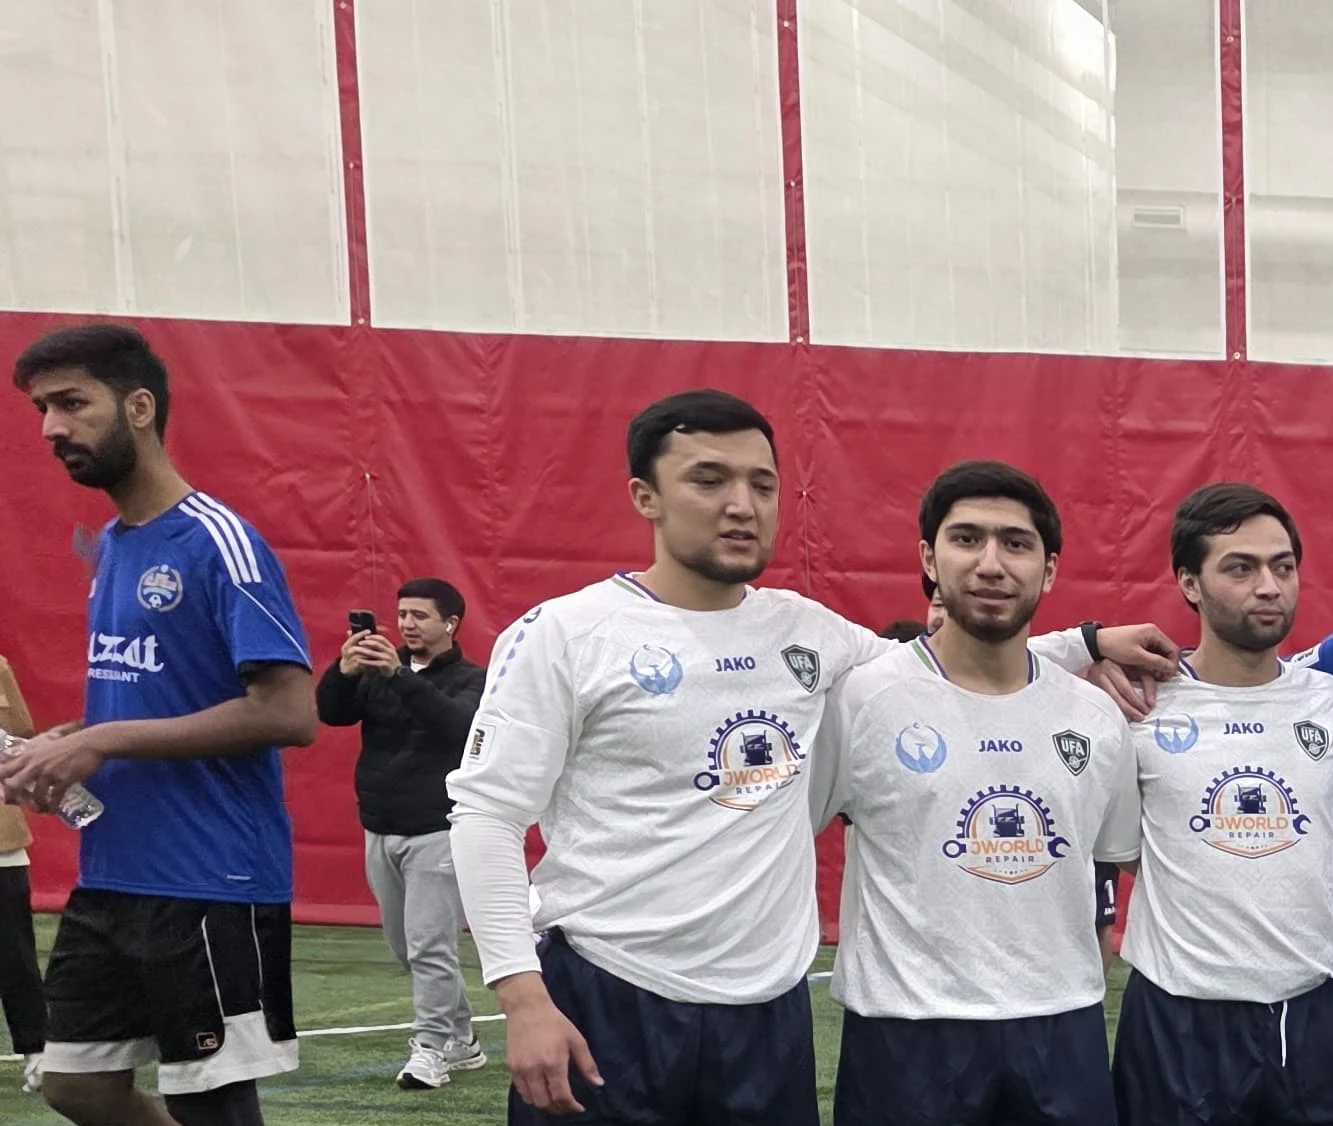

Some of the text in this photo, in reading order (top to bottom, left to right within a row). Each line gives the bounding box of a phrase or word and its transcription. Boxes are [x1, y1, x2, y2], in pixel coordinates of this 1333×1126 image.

[715, 655, 756, 673] JAKO
[789, 653, 814, 673] UFA
[1223, 722, 1265, 736] JAKO
[1301, 728, 1324, 745] UFA
[978, 740, 1023, 754] JAKO
[1060, 740, 1086, 758] UFA
[1215, 816, 1289, 831] JWORLD
[1228, 831, 1275, 839] REPAIR
[970, 839, 1044, 855] JWORLD
